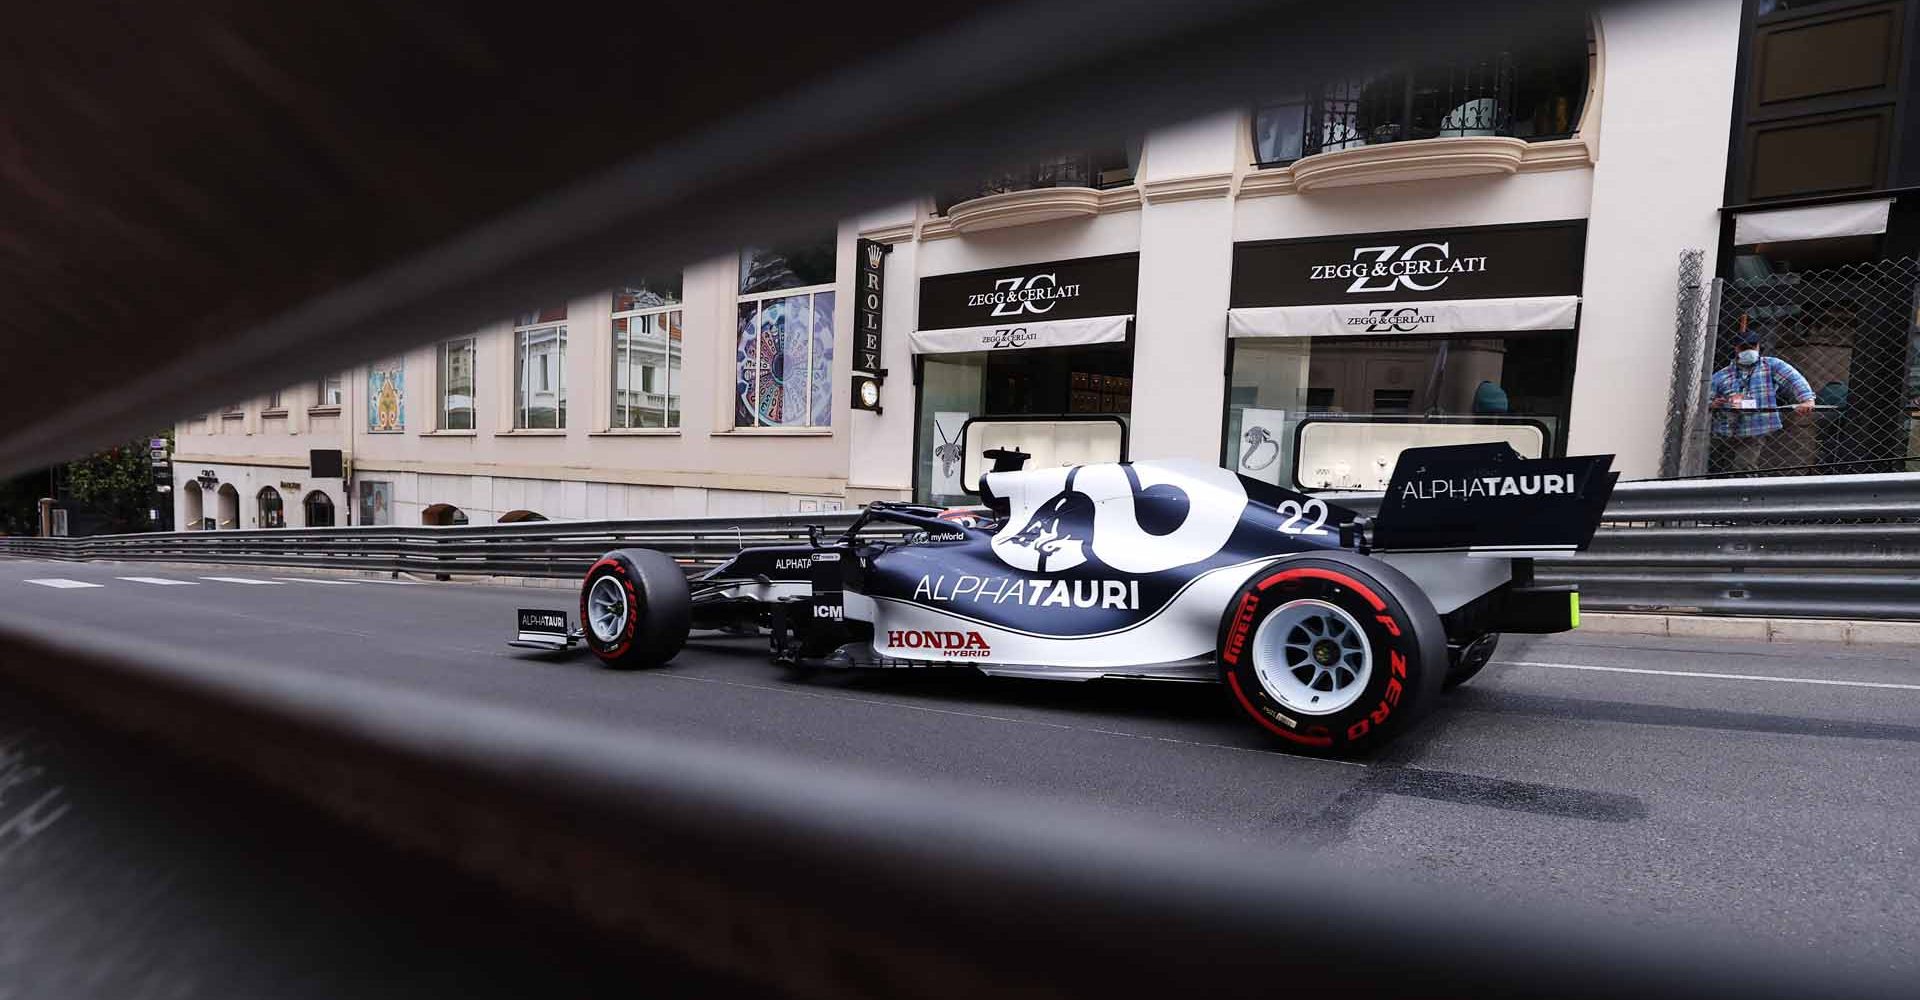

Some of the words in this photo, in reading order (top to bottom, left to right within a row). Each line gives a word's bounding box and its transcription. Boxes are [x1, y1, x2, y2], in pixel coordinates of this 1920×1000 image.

[1310, 263, 1369, 279] ZEGG
[968, 292, 1005, 306] ZEGG
[864, 273, 880, 370] ROLEX
[1402, 473, 1576, 500] ALPHATAURI
[1276, 499, 1329, 536] 22
[930, 532, 964, 542] myWorld
[913, 574, 1140, 610] ALPHATAURI
[522, 614, 565, 628] ALPHATAURI
[814, 605, 843, 618] ICM
[1376, 615, 1401, 637] P
[888, 630, 991, 650] HONDA
[1347, 650, 1407, 740] ZERO
